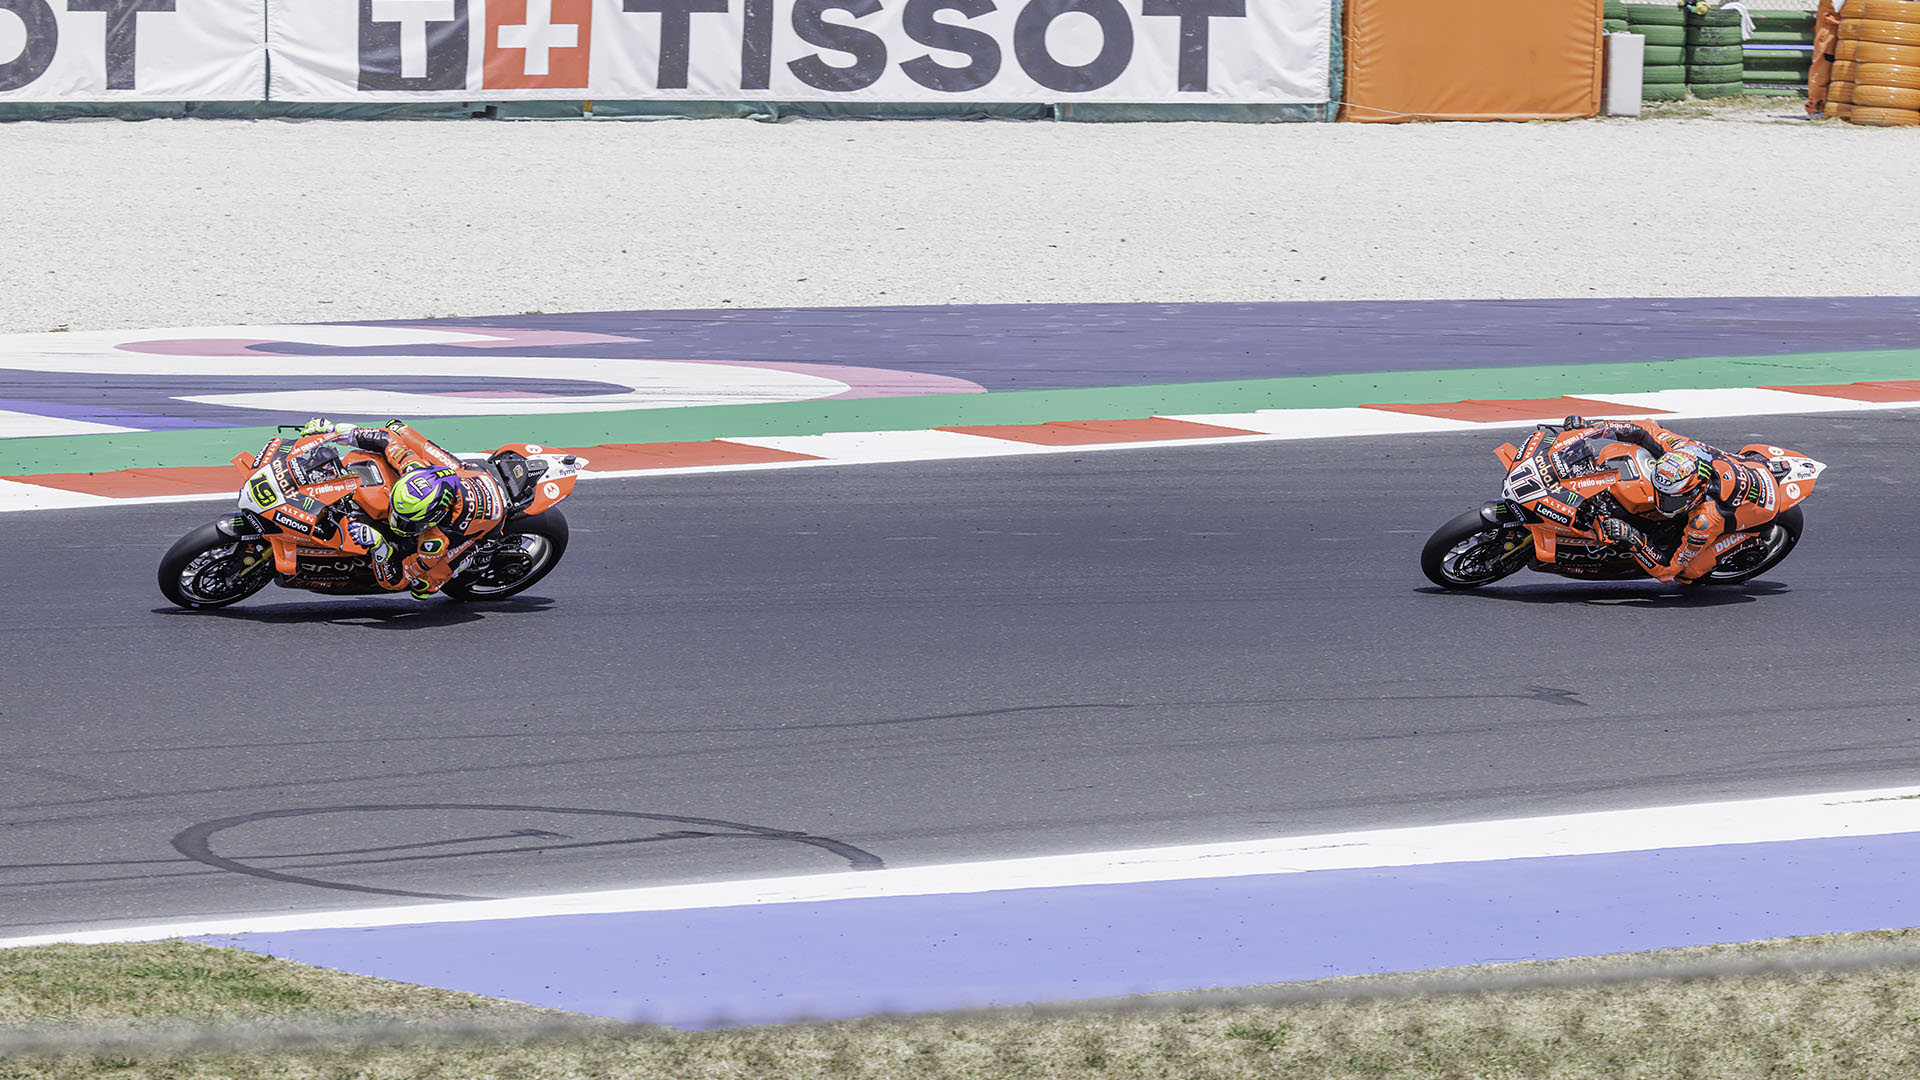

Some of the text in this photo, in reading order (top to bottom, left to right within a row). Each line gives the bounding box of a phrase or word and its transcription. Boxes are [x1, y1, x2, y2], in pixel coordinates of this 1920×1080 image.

[622, 0, 1246, 93] TISSOT
[248, 473, 278, 509] 19
[315, 483, 334, 495] riello
[1509, 464, 1545, 499] 11
[1577, 479, 1595, 488] riello
[280, 506, 315, 523] ALTEN
[1537, 504, 1568, 524] Lenovo
[1543, 498, 1575, 516] ALTEN
[275, 513, 309, 532] Lenovo
[1715, 533, 1748, 553] DUCA
